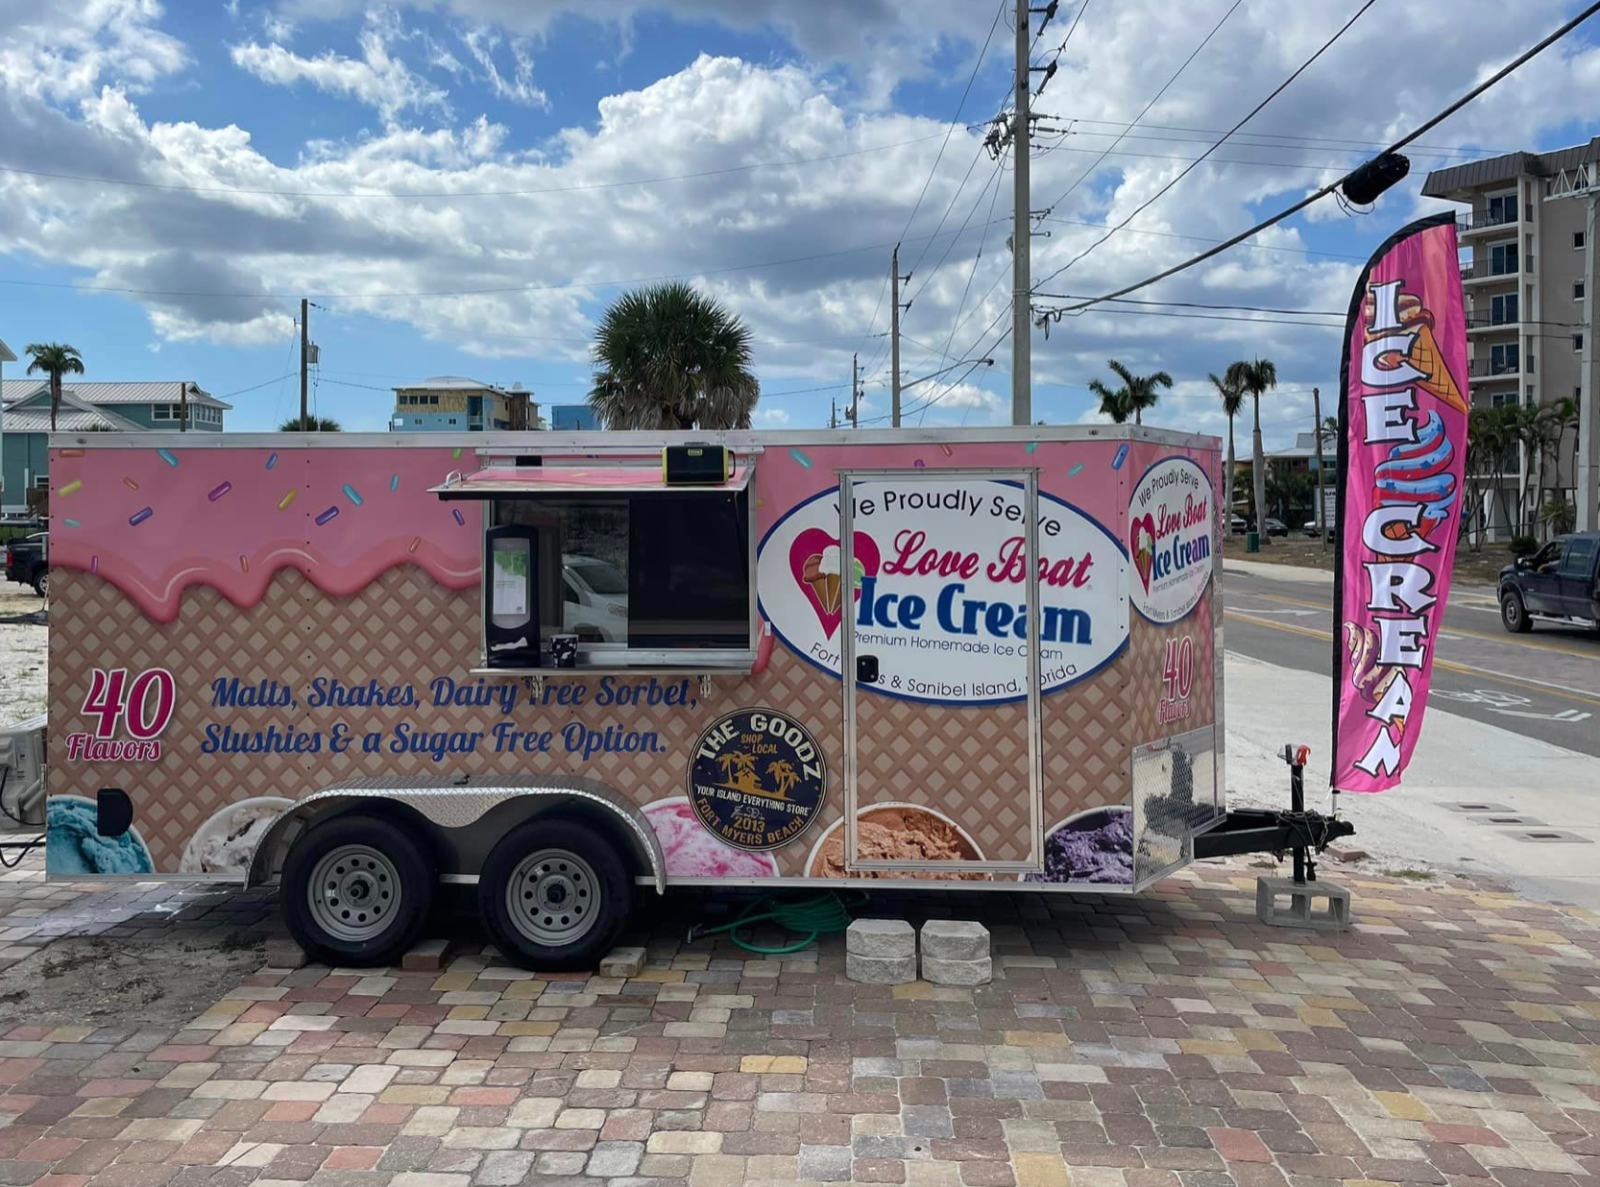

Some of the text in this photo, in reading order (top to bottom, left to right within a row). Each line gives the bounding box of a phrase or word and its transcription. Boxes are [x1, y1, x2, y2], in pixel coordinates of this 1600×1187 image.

[1138, 468, 1199, 508] We Proudly Serve
[884, 489, 983, 516] Proudly
[990, 496, 1061, 536] See
[1156, 491, 1207, 539] Love Boat
[1353, 279, 1440, 779] ICE CREAM
[883, 529, 980, 579] Love
[1151, 544, 1171, 581] Ice
[1173, 534, 1210, 571] Cream
[856, 576, 926, 630] Ice
[810, 642, 840, 666] Fort
[891, 675, 902, 689] &
[907, 678, 966, 696] Sanibel
[972, 679, 1021, 696] Island,
[1026, 664, 1077, 686] orida
[911, 636, 989, 654] Homemade
[994, 643, 1013, 656] Ice
[1018, 645, 1063, 659] Cam
[1163, 634, 1193, 702] 40
[80, 667, 176, 740] 40
[211, 677, 297, 711] Malts,
[307, 676, 420, 710] Shakes,
[430, 676, 517, 715] Dairy
[595, 675, 697, 709] Sorbet,
[65, 732, 161, 761] Flavors
[201, 722, 666, 762] Slushies & a Sugar Free Option.
[696, 713, 822, 781] THE GOODZ
[741, 733, 763, 744] SHOP
[752, 744, 778, 754] LOCAL
[697, 797, 722, 828] FORT
[721, 824, 763, 845] MYERS
[766, 815, 805, 844] BEACH
[716, 789, 742, 802] ISLAND
[743, 794, 785, 812] EVERYTHING
[734, 815, 765, 834] 2013
